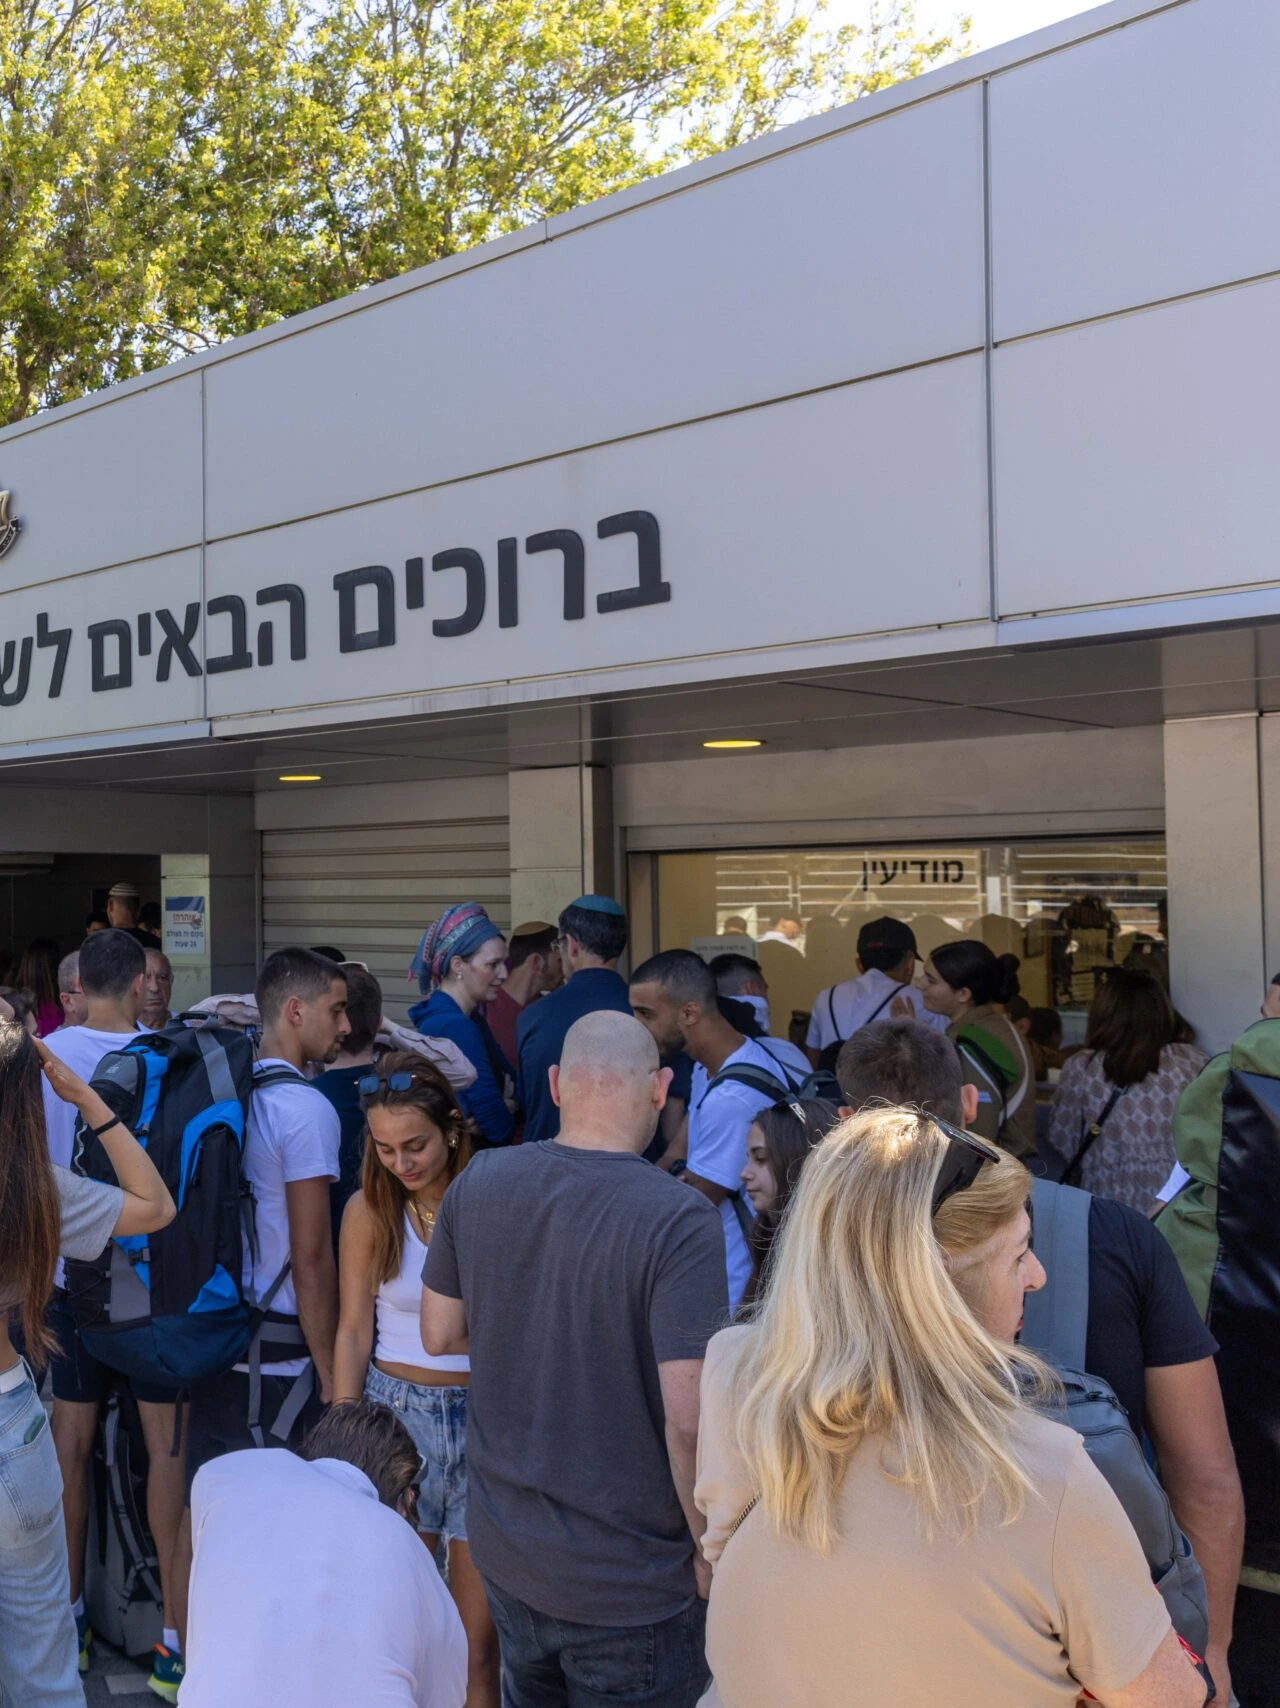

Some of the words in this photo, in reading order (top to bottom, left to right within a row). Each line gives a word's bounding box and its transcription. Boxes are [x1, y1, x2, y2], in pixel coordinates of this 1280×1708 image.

[332, 510, 671, 654] ברוכים
[88, 583, 306, 693] הבאים
[863, 860, 964, 892] מודיעין
